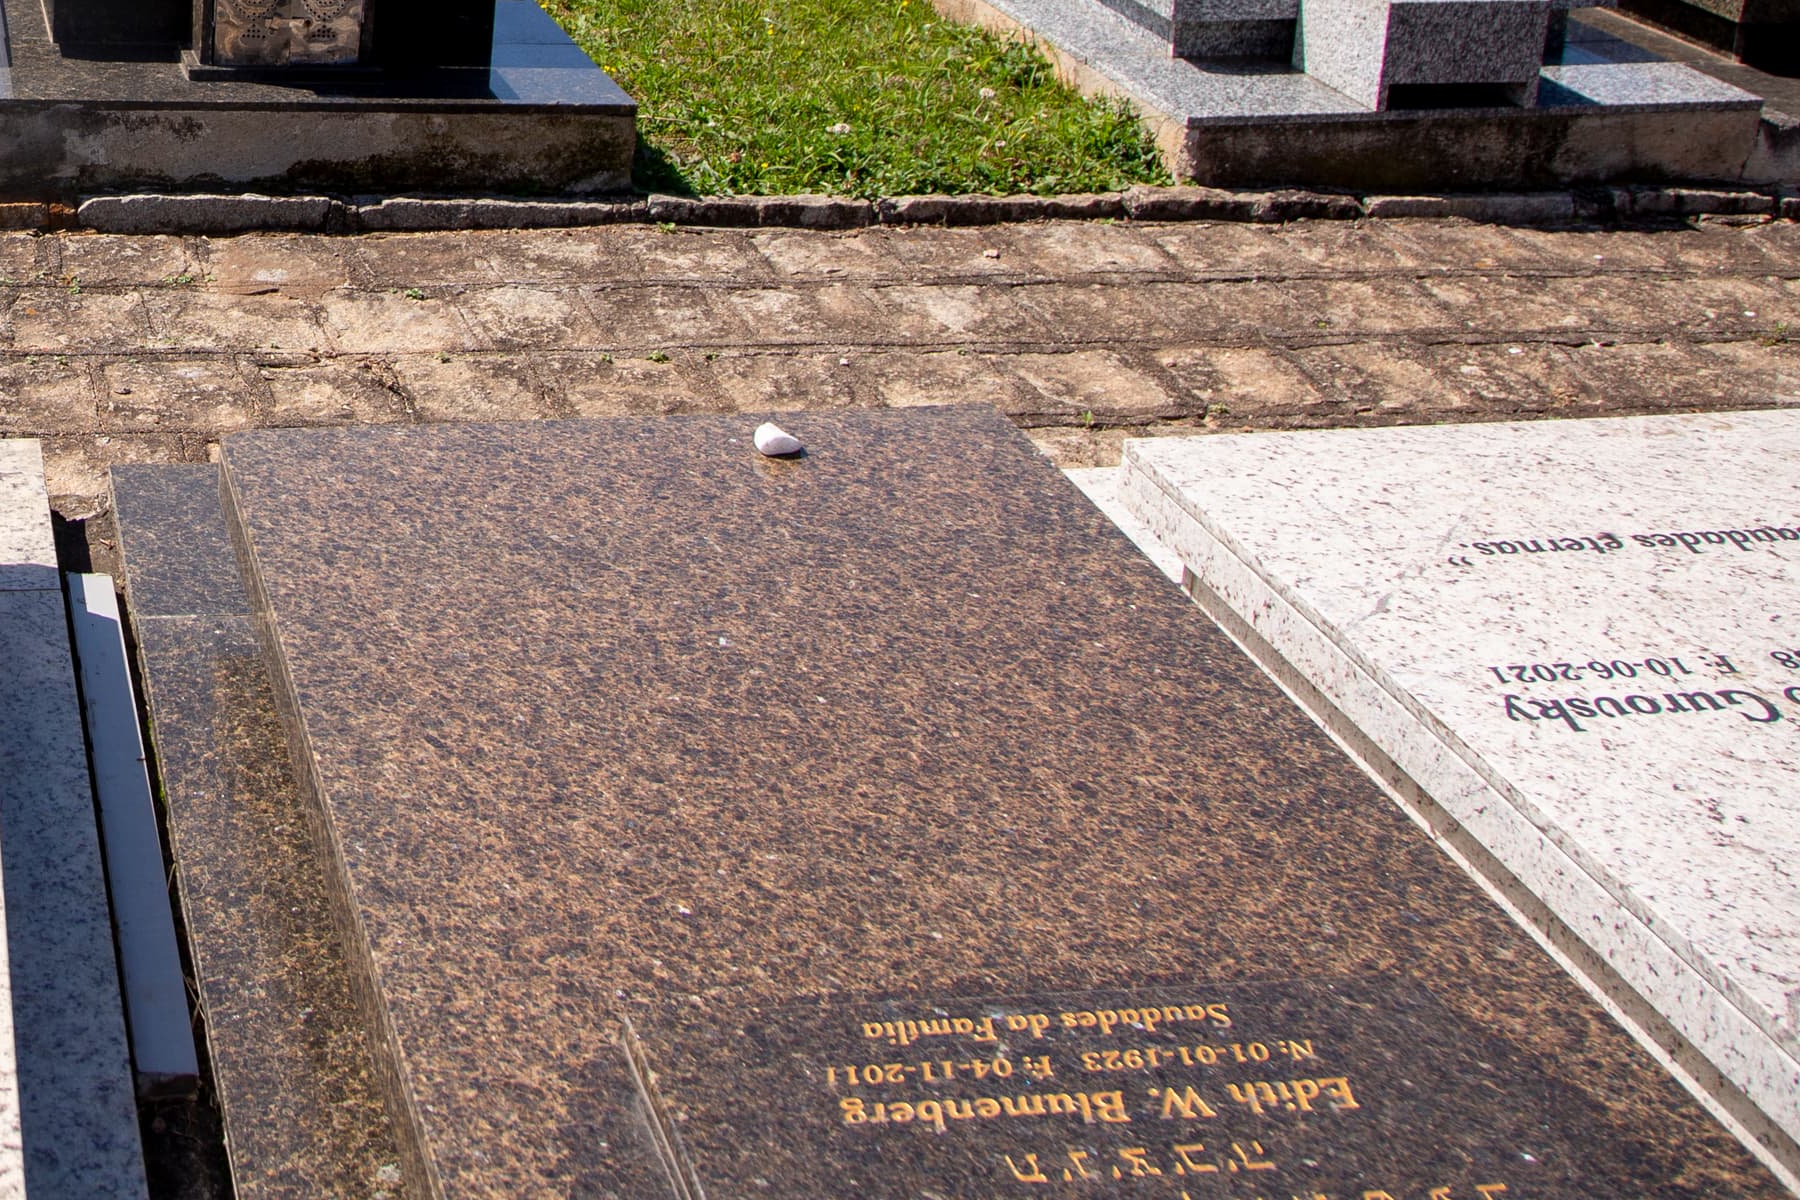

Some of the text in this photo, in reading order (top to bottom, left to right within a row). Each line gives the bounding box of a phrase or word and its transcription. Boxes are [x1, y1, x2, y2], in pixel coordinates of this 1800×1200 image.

[1630, 524, 1800, 555] audades
[1487, 654, 1739, 685] F: 10-06-2021
[1502, 688, 1782, 734] Gurovsky
[861, 1001, 1233, 1047] Saudades da Família
[825, 1038, 1314, 1087] N: 01-01-1923 F: 04-11-2011
[838, 1075, 1361, 1136] Edith W. Blumenberg
